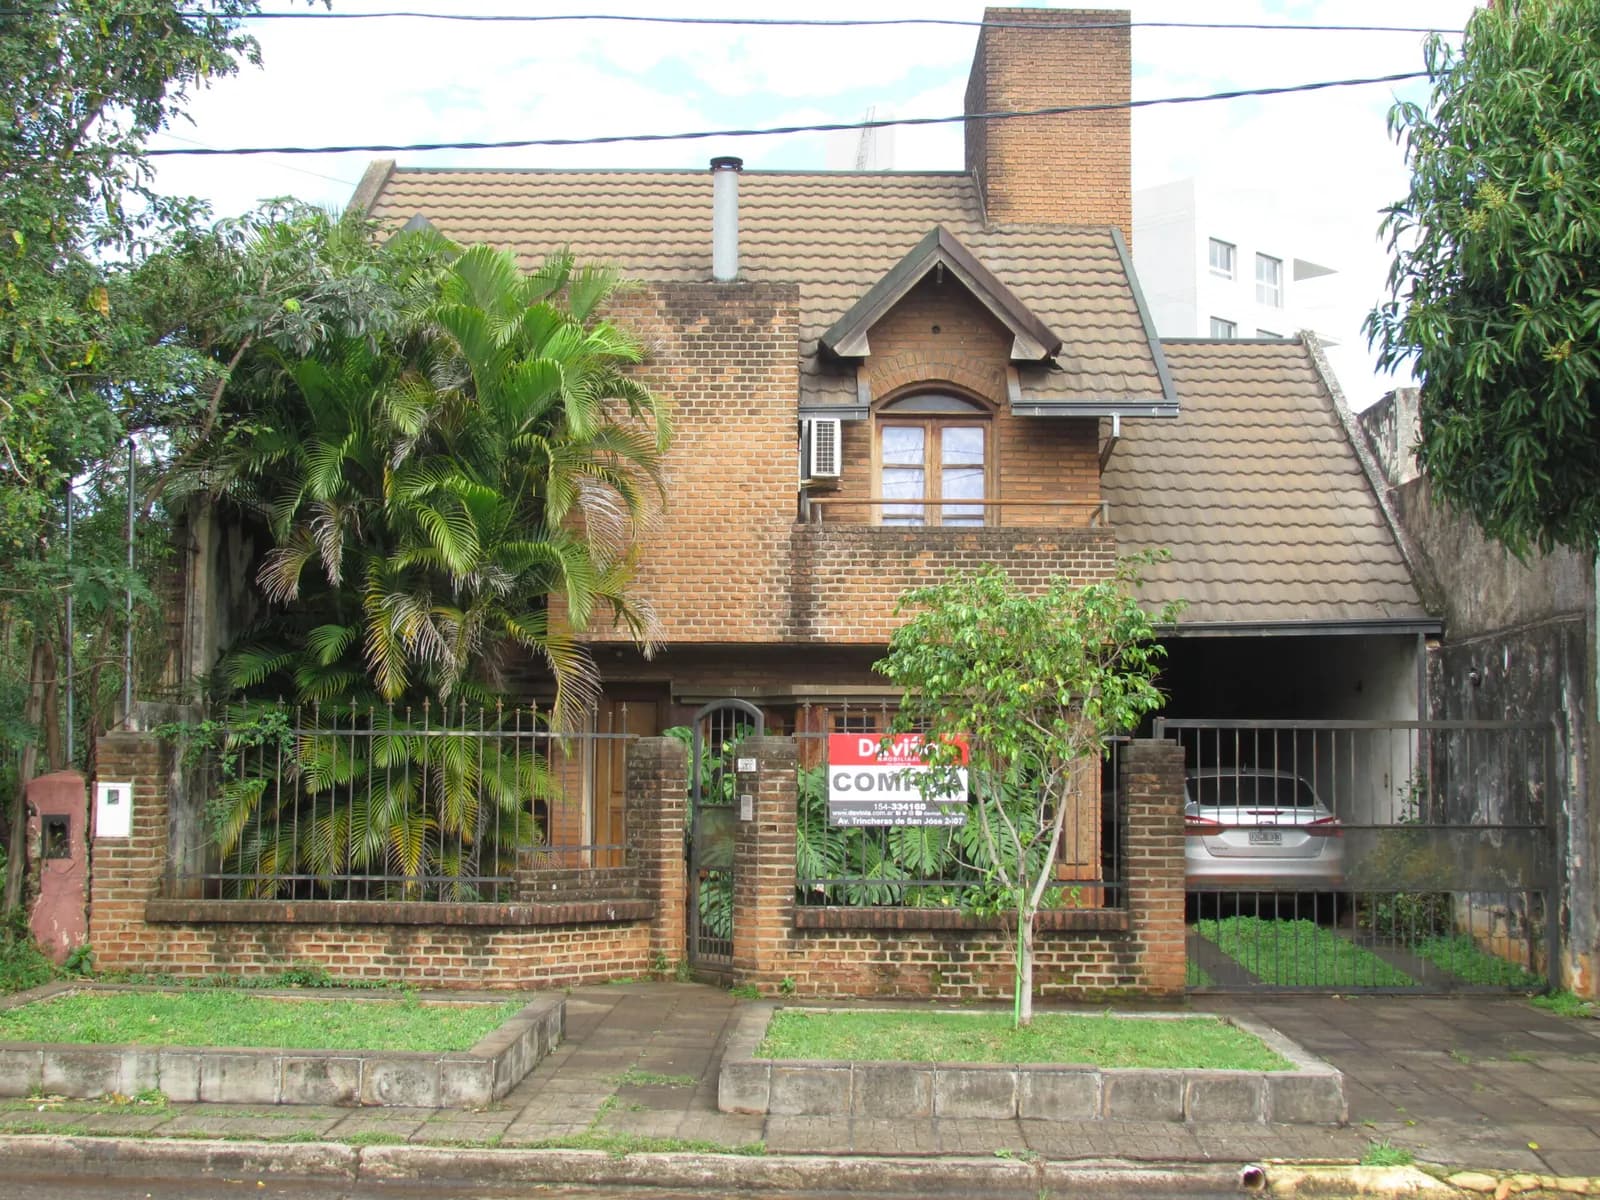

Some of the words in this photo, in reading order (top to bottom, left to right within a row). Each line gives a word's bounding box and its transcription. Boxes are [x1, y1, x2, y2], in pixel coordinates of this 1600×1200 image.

[833, 772, 965, 792] COMPA
[837, 817, 849, 825] Av.
[852, 817, 893, 825] Trincheras
[895, 817, 905, 825] de
[907, 817, 922, 825] San
